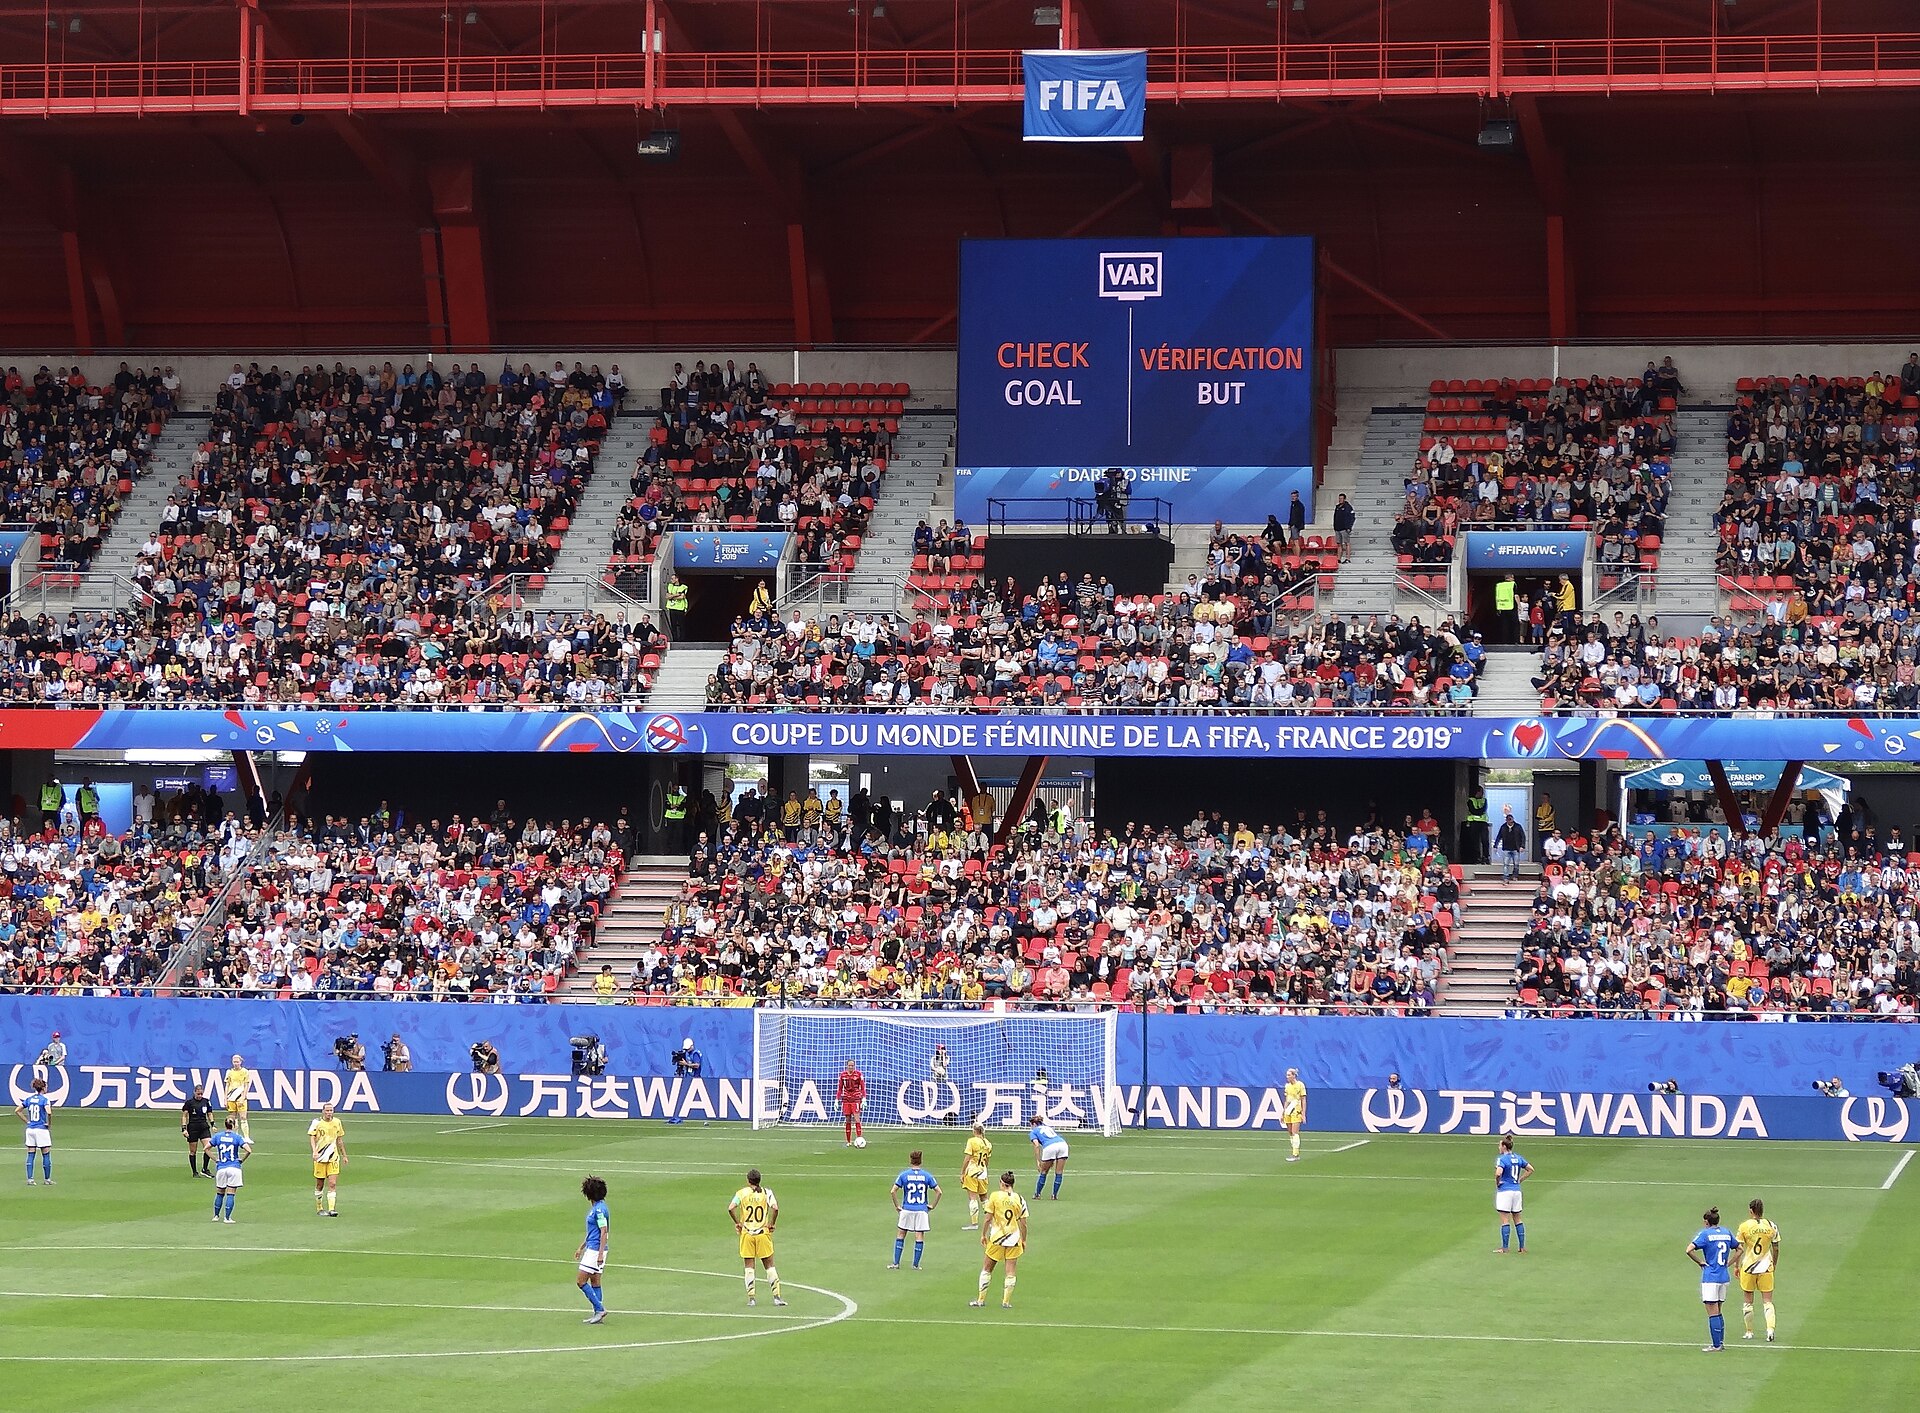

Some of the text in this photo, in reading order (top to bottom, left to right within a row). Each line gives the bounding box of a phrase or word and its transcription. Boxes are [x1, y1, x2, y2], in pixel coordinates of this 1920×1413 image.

[1039, 80, 1126, 111] FIFA
[1107, 263, 1155, 287] VAR
[998, 342, 1090, 369] CHECK
[1140, 343, 1302, 370] VÉRIFICATION
[1004, 380, 1082, 406] GOAL
[1198, 382, 1245, 405] BUT
[1498, 545, 1557, 555] #FIFAWWC
[731, 723, 823, 746] COUPE
[831, 724, 868, 746] DU
[877, 724, 977, 749] MONDE
[983, 720, 1116, 750] FÉMININE
[1124, 726, 1160, 748] DE
[1167, 726, 1201, 748] LA
[1206, 725, 1270, 752] FIFA,
[1276, 726, 1386, 751] FRANCE
[1730, 774, 1745, 782] FAN
[1745, 773, 1765, 782] SHOP
[80, 1066, 190, 1110] 万达
[519, 1074, 828, 1120] 万达 WANDA
[29, 1103, 40, 1122] 18
[972, 1082, 1288, 1129] 万达 WANDA
[1440, 1090, 1768, 1138] 万达 WANDA
[219, 1143, 235, 1163] 21
[1511, 1165, 1519, 1184] 4
[907, 1183, 926, 1204] 23
[745, 1205, 764, 1223] 20
[1004, 1209, 1013, 1226] 9
[1717, 1241, 1727, 1266] 2
[1753, 1237, 1762, 1255] 6
